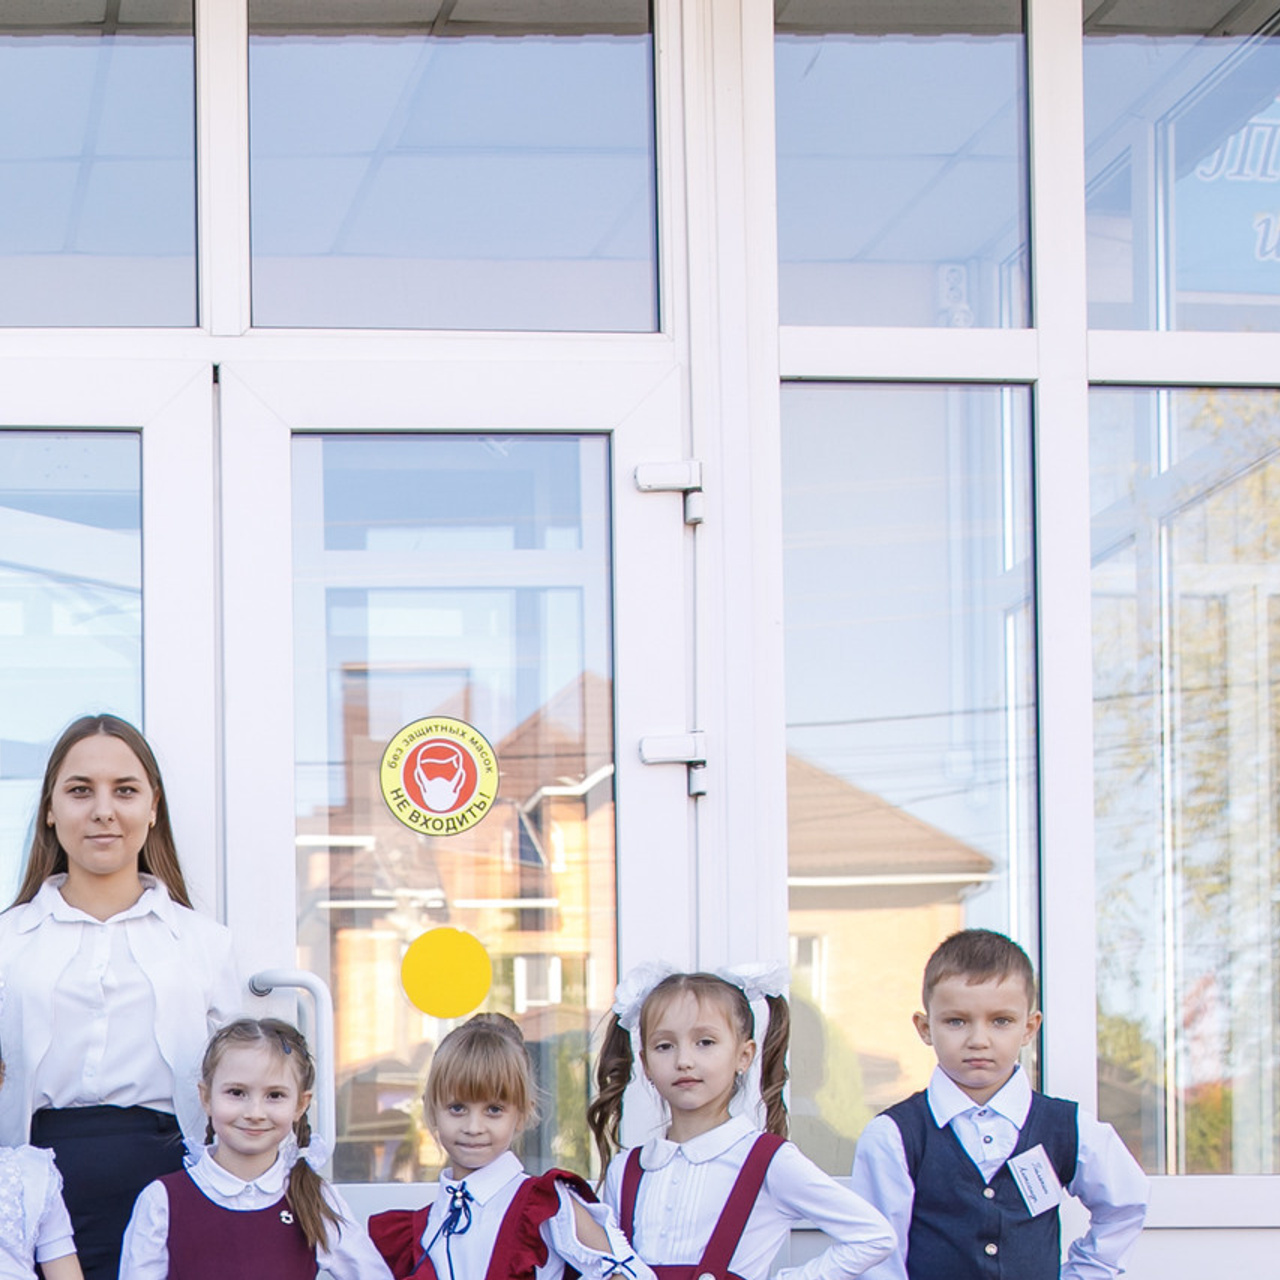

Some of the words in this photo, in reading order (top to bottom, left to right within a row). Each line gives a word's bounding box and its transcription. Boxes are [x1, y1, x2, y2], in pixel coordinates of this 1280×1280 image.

[387, 747, 404, 769] без
[403, 724, 467, 747] защитных
[469, 736, 493, 773] масок
[390, 787, 411, 812] НЕ
[408, 791, 491, 833] ВХОДИТЬ!
